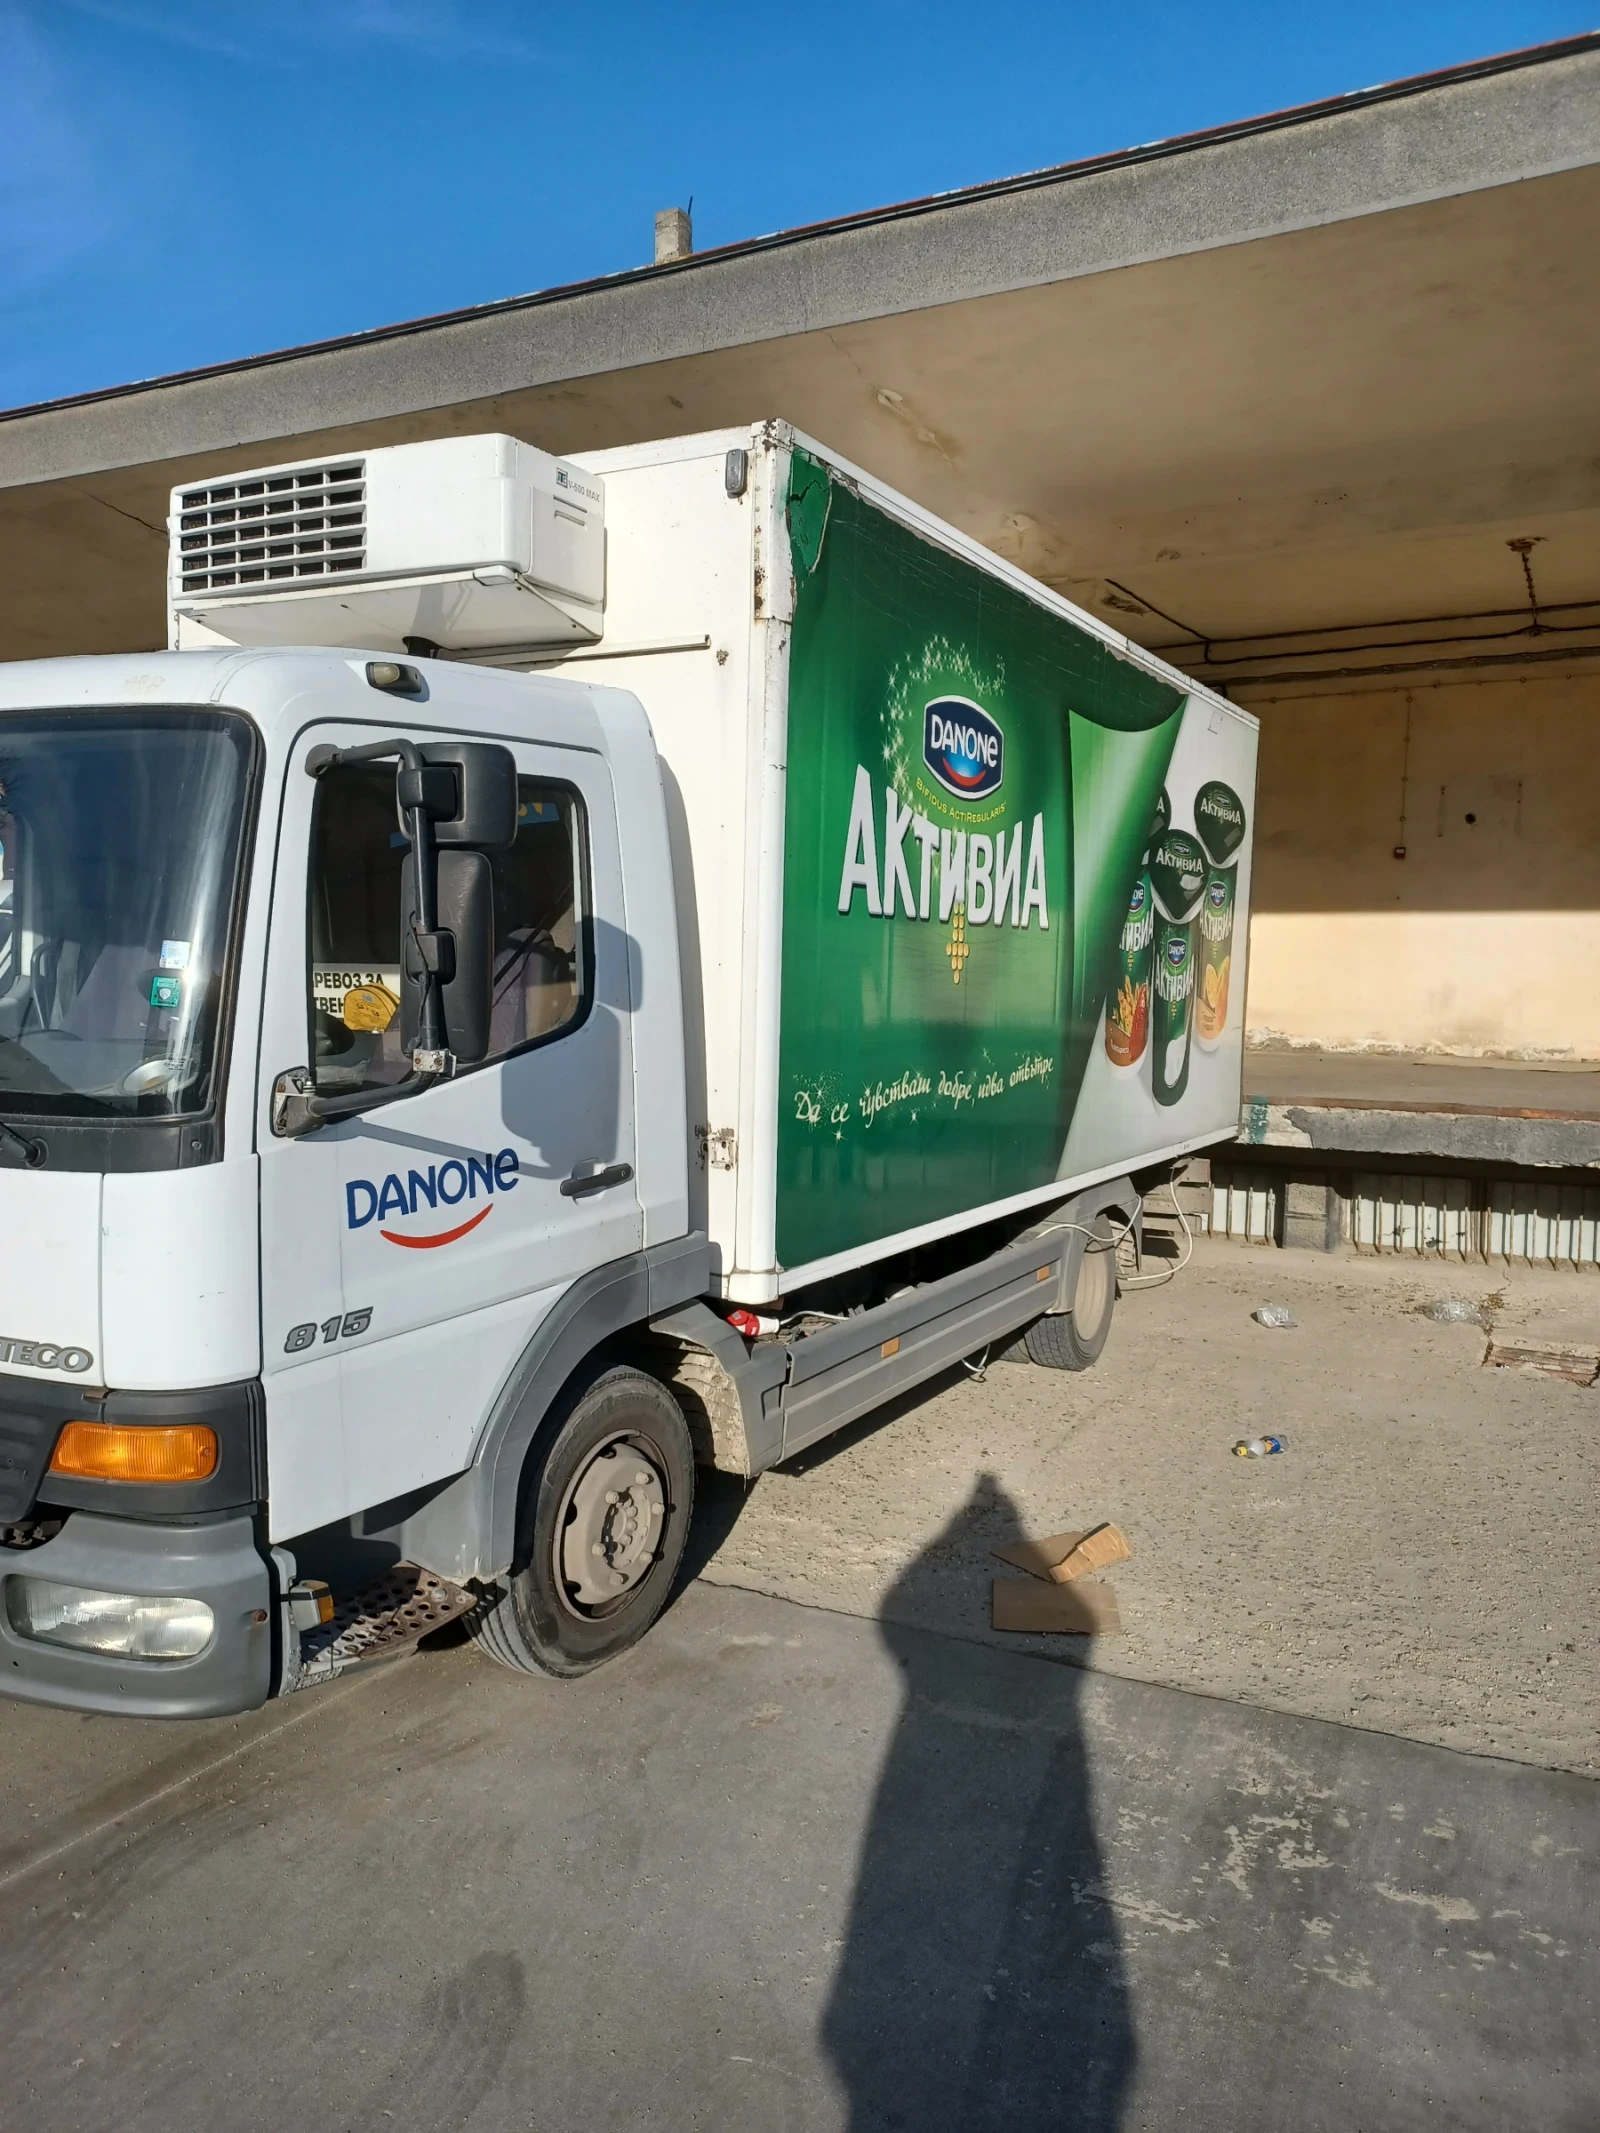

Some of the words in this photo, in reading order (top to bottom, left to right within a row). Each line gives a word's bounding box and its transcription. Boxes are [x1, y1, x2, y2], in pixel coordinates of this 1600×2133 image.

[586, 488, 600, 503] MAX
[915, 776, 948, 814] BIFIDUS
[1200, 797, 1242, 826] АКТИВИА
[838, 764, 1049, 929] АКТИВИА
[1155, 847, 1204, 873] АКТИВИА
[1154, 952, 1194, 1003] АКТИВИА
[794, 1090, 822, 1122] Да
[831, 1102, 850, 1123] се
[859, 1071, 933, 1128] чувстваш
[938, 1071, 975, 1110] добре,
[978, 1071, 1005, 1098] идва
[1009, 1056, 1054, 1084] отвътре
[284, 1306, 374, 1353] 815
